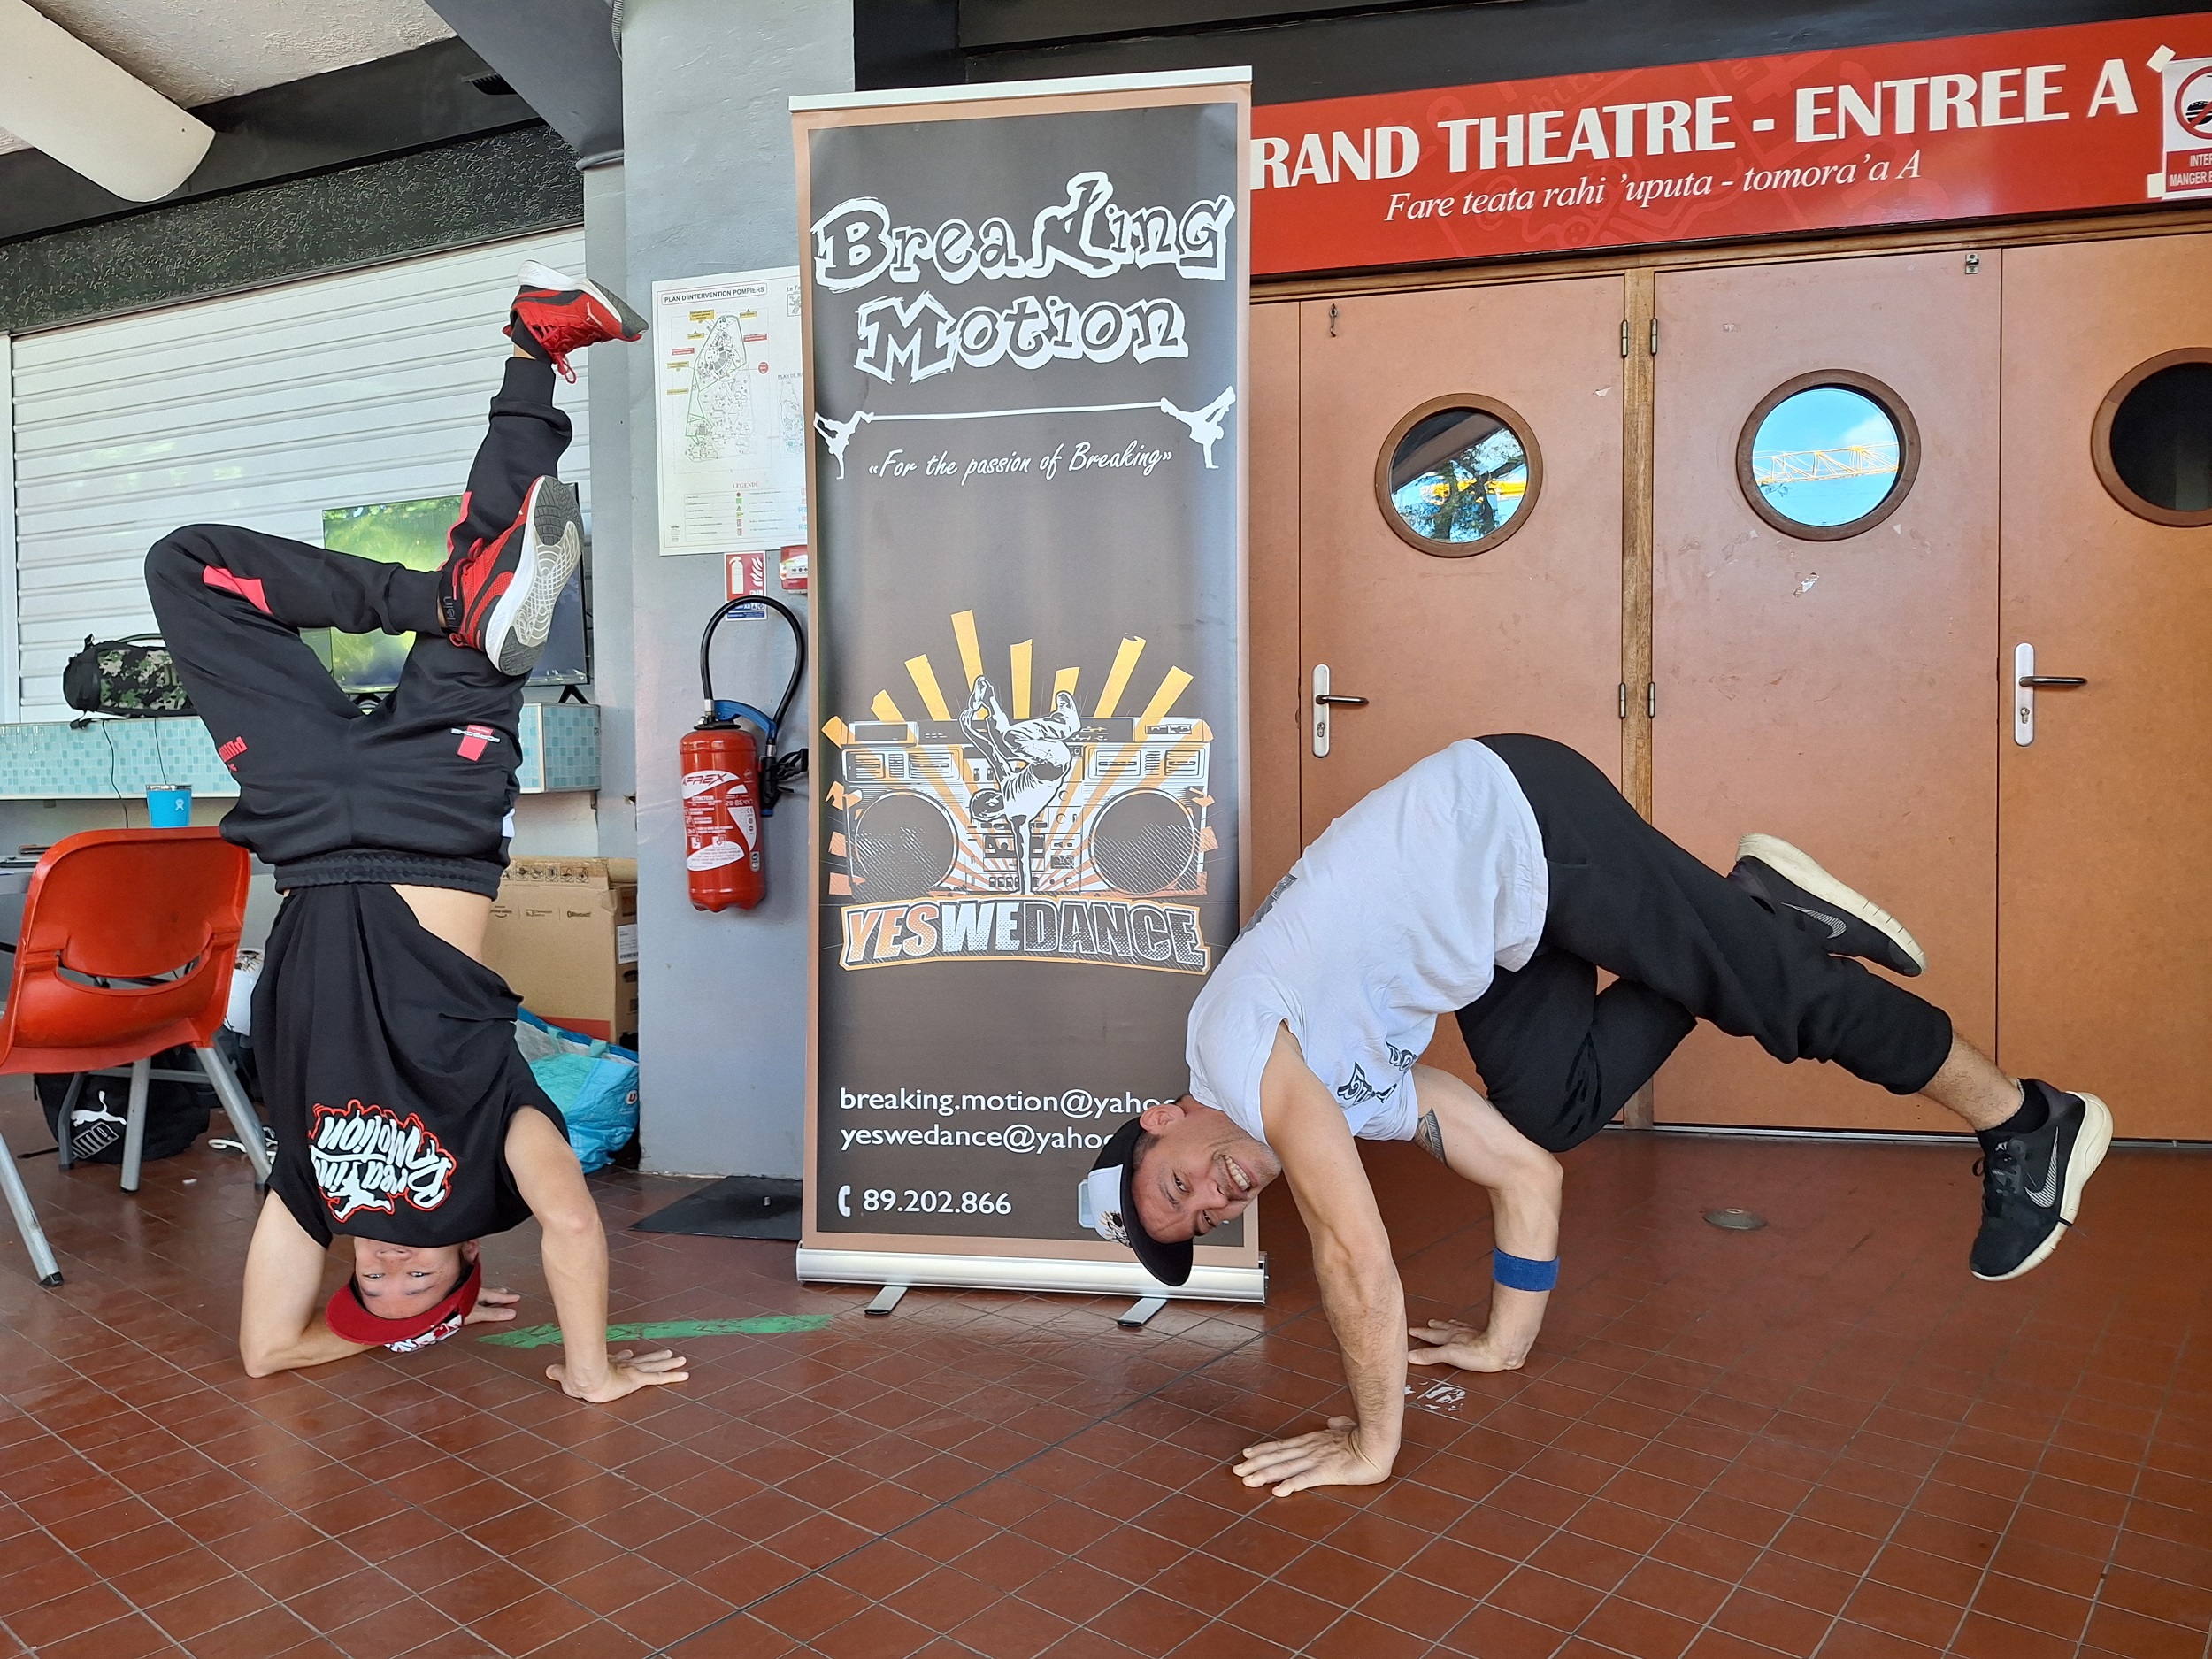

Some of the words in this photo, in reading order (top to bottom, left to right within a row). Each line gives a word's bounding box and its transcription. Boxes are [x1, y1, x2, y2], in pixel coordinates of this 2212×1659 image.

[1438, 96, 1736, 173] THEATRE
[1753, 119, 1775, 133] -
[1796, 64, 2069, 142] ENTREE
[2087, 58, 2139, 119] A
[1384, 192, 1455, 222] Fare
[1463, 187, 1534, 216] teata
[1543, 181, 1605, 209] rahi
[1900, 150, 1922, 180] A
[2170, 171, 2208, 187] MANGER
[810, 171, 1236, 293] Breaking
[681, 290, 731, 301] D'INTERVENTION
[733, 286, 764, 296] POMPIERS
[855, 291, 1189, 384] Motion
[926, 450, 958, 476] the
[961, 455, 1032, 486] passion
[1040, 444, 1065, 480] of
[841, 1123, 1114, 1154] yeswedance@yaho
[863, 1188, 1012, 1215] 89.202.866
